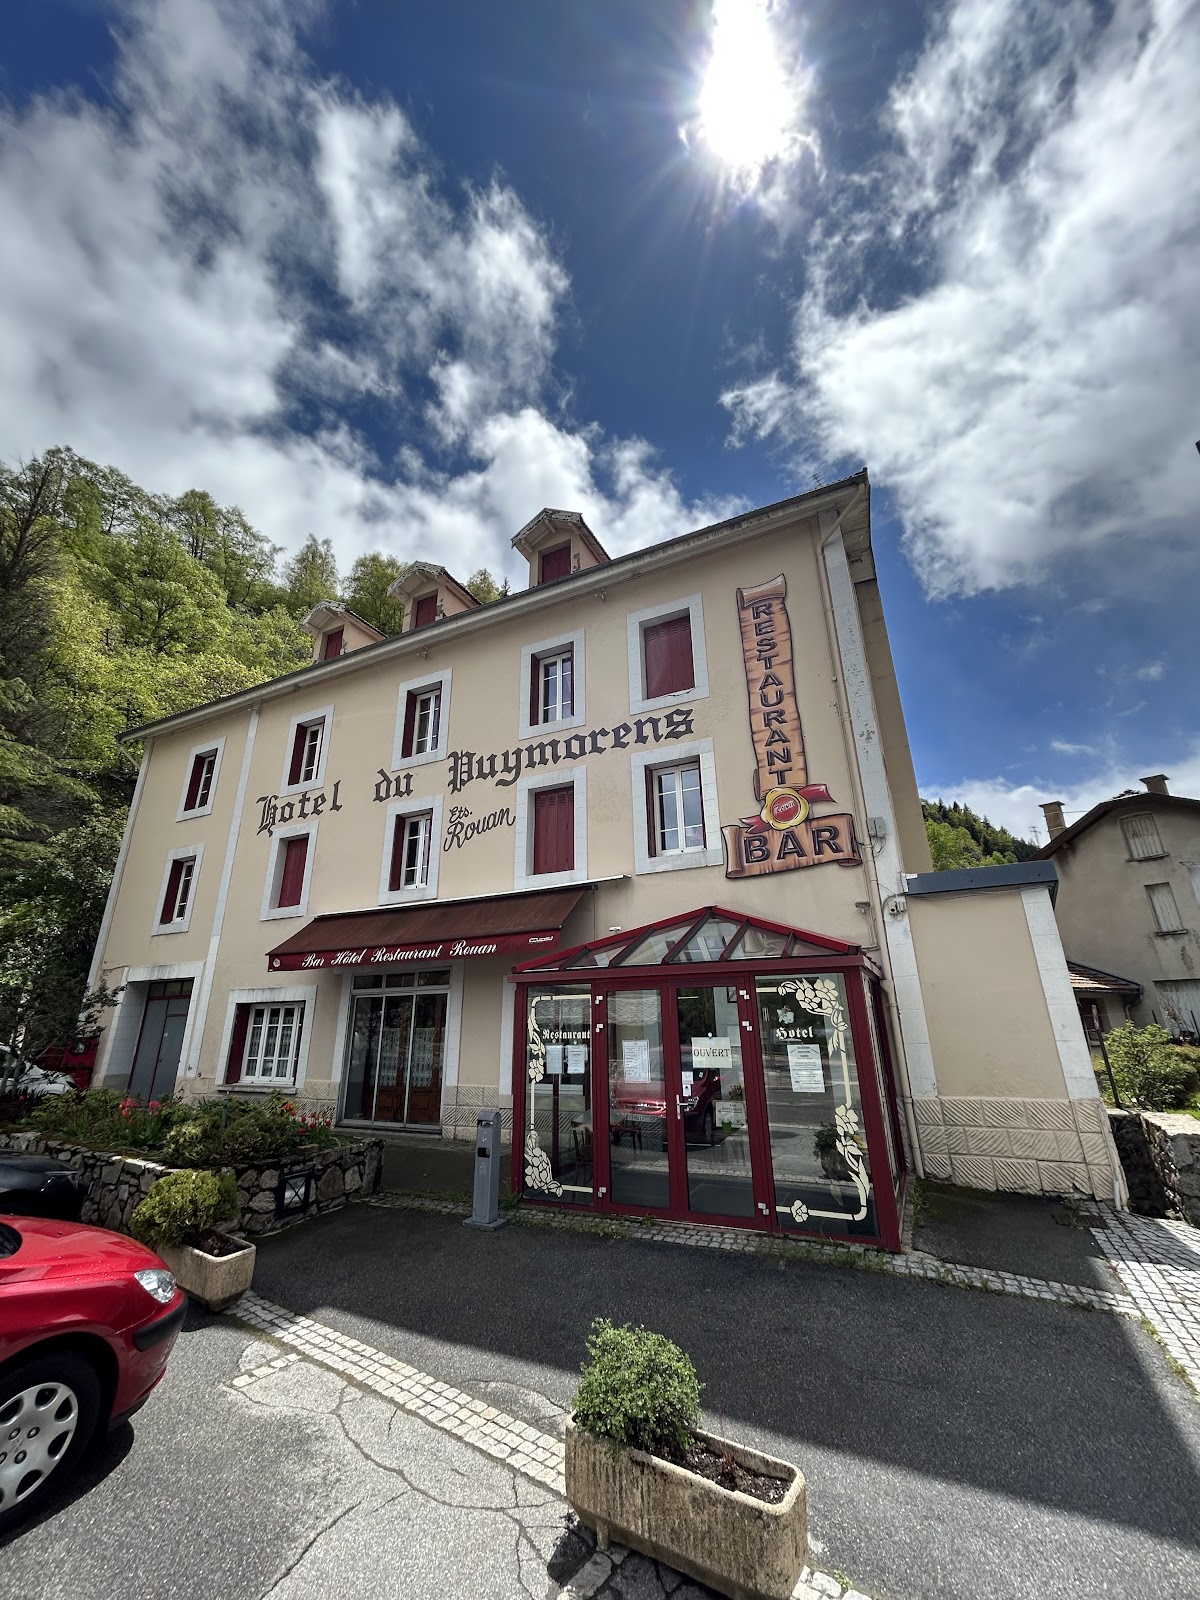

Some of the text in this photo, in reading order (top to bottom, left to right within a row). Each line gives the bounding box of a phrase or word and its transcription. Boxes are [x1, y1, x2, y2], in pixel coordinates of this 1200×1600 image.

[751, 602, 793, 786] RESTAURANT
[373, 768, 414, 802] du
[447, 708, 694, 794] Puymorens
[449, 806, 472, 823] Ets.
[443, 807, 516, 852] Rouan
[743, 825, 844, 864] BAR
[302, 940, 497, 967] Bar Hôtel Restaurant Rouan
[542, 1029, 591, 1039] Restaurant
[776, 1026, 814, 1040] Hotel
[693, 1048, 730, 1057] OUVERT
